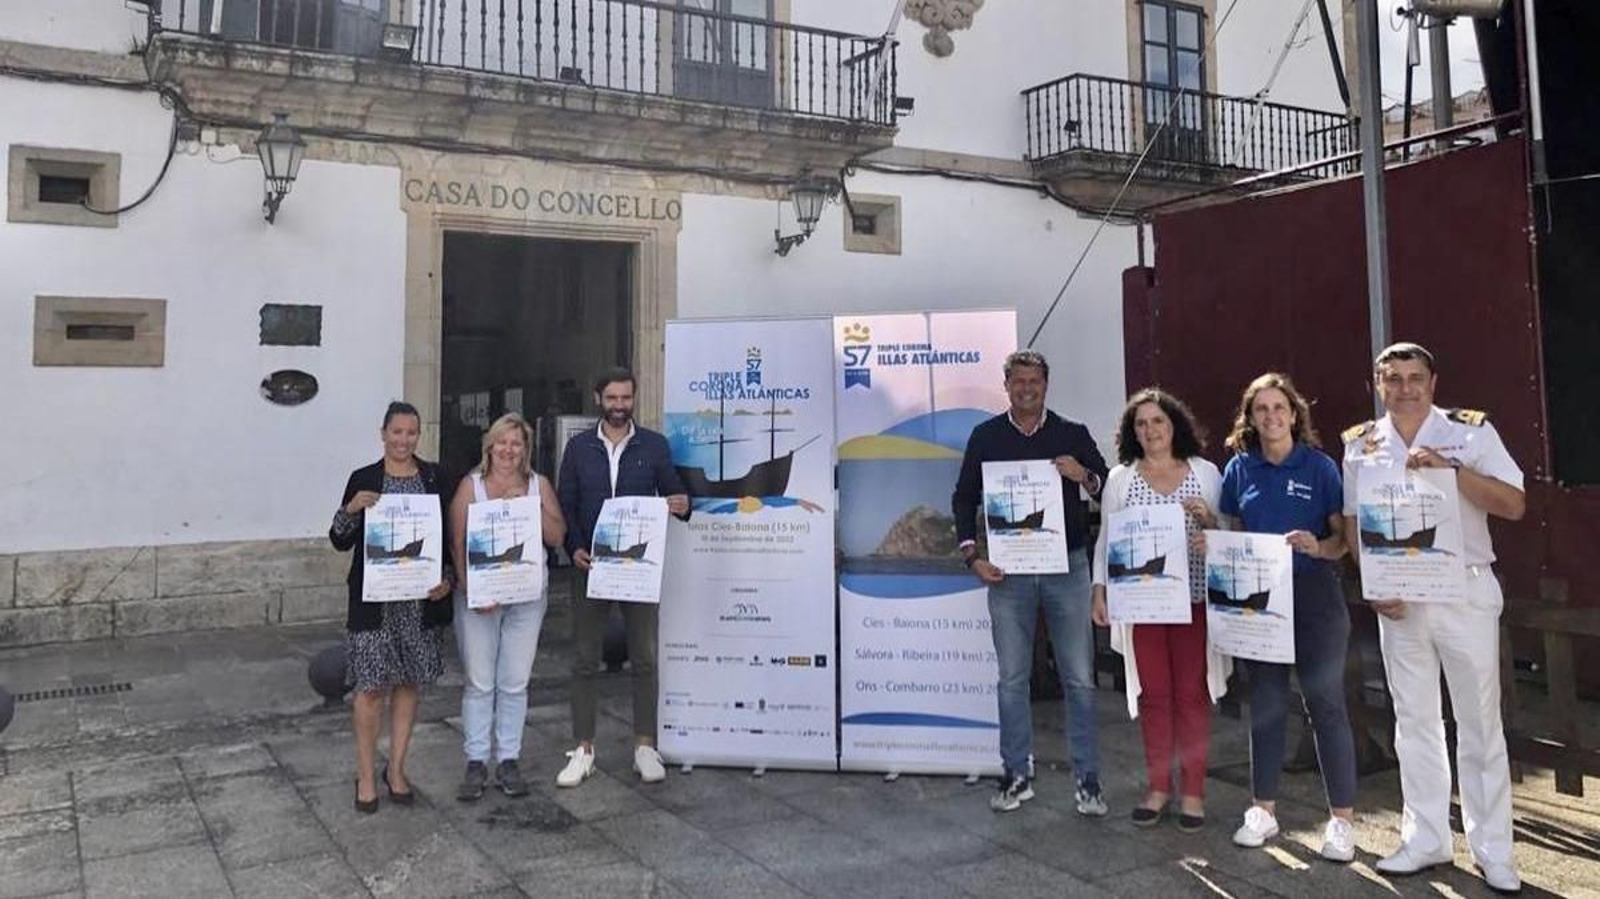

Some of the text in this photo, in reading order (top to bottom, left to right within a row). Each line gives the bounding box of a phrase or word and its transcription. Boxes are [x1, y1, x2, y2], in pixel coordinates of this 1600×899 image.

[404, 178, 682, 221] CASA DO CONCELLO
[902, 343, 932, 351] CORONA
[877, 350, 981, 366] ILLAS ATLÁNTICAS
[708, 372, 741, 381] TRIPLE
[689, 380, 744, 392] CORONA
[704, 387, 810, 400] ILLAS ATLÁNTICAS
[893, 618, 930, 630] Baiona
[933, 619, 949, 630] (15
[952, 619, 973, 630] km)
[902, 650, 940, 662] Ribeira
[943, 651, 959, 662] (19
[962, 650, 982, 662] km)
[856, 681, 877, 692] Ons
[886, 681, 940, 694] Combarro
[943, 682, 959, 695] (23
[962, 682, 982, 694] km)
